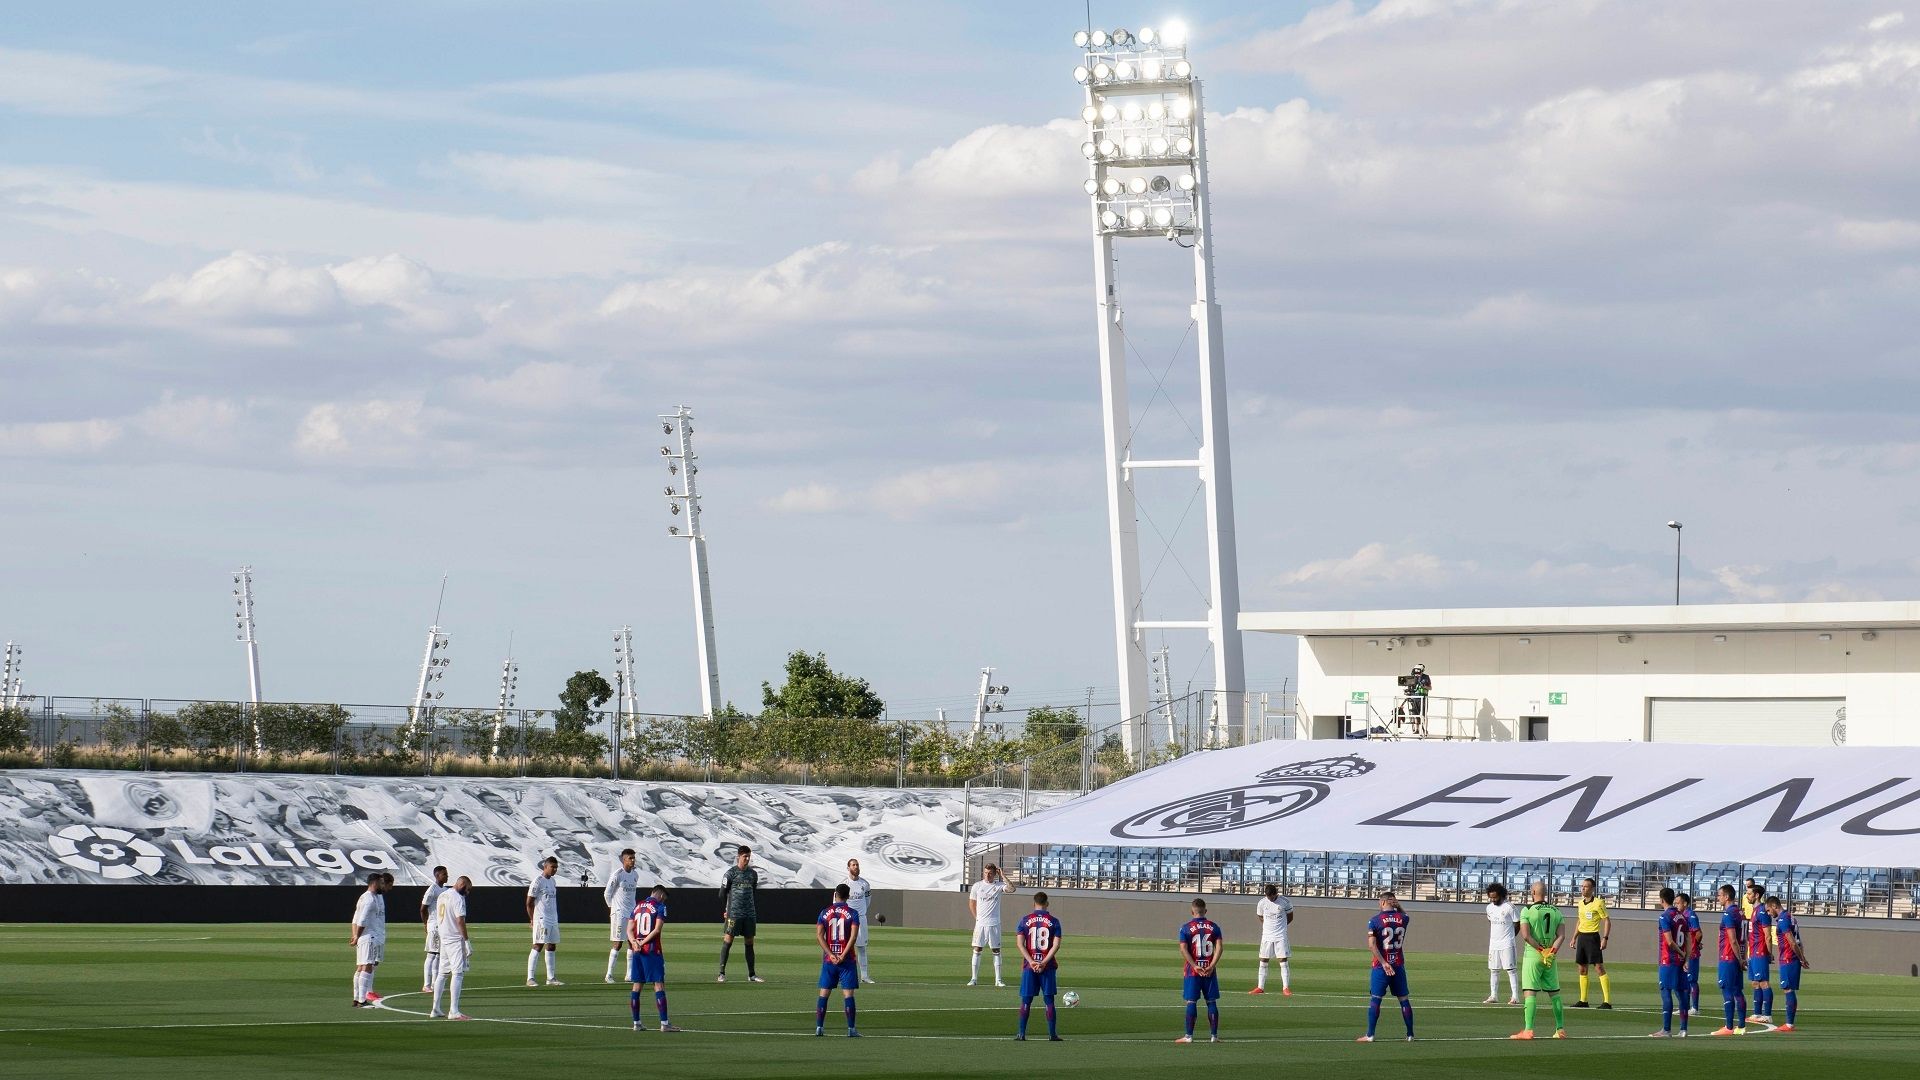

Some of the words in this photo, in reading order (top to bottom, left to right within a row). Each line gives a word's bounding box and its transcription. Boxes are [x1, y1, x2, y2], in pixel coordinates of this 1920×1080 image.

[1357, 772, 1703, 833] EN
[172, 839, 400, 875] LaLiga
[438, 903, 446, 924] 9
[635, 912, 651, 936] 10
[1543, 912, 1551, 934] 1
[829, 917, 845, 941] 11
[1028, 926, 1050, 951] 18
[1381, 926, 1406, 950] 23
[1677, 924, 1685, 947] 6
[1192, 933, 1214, 958] 16
